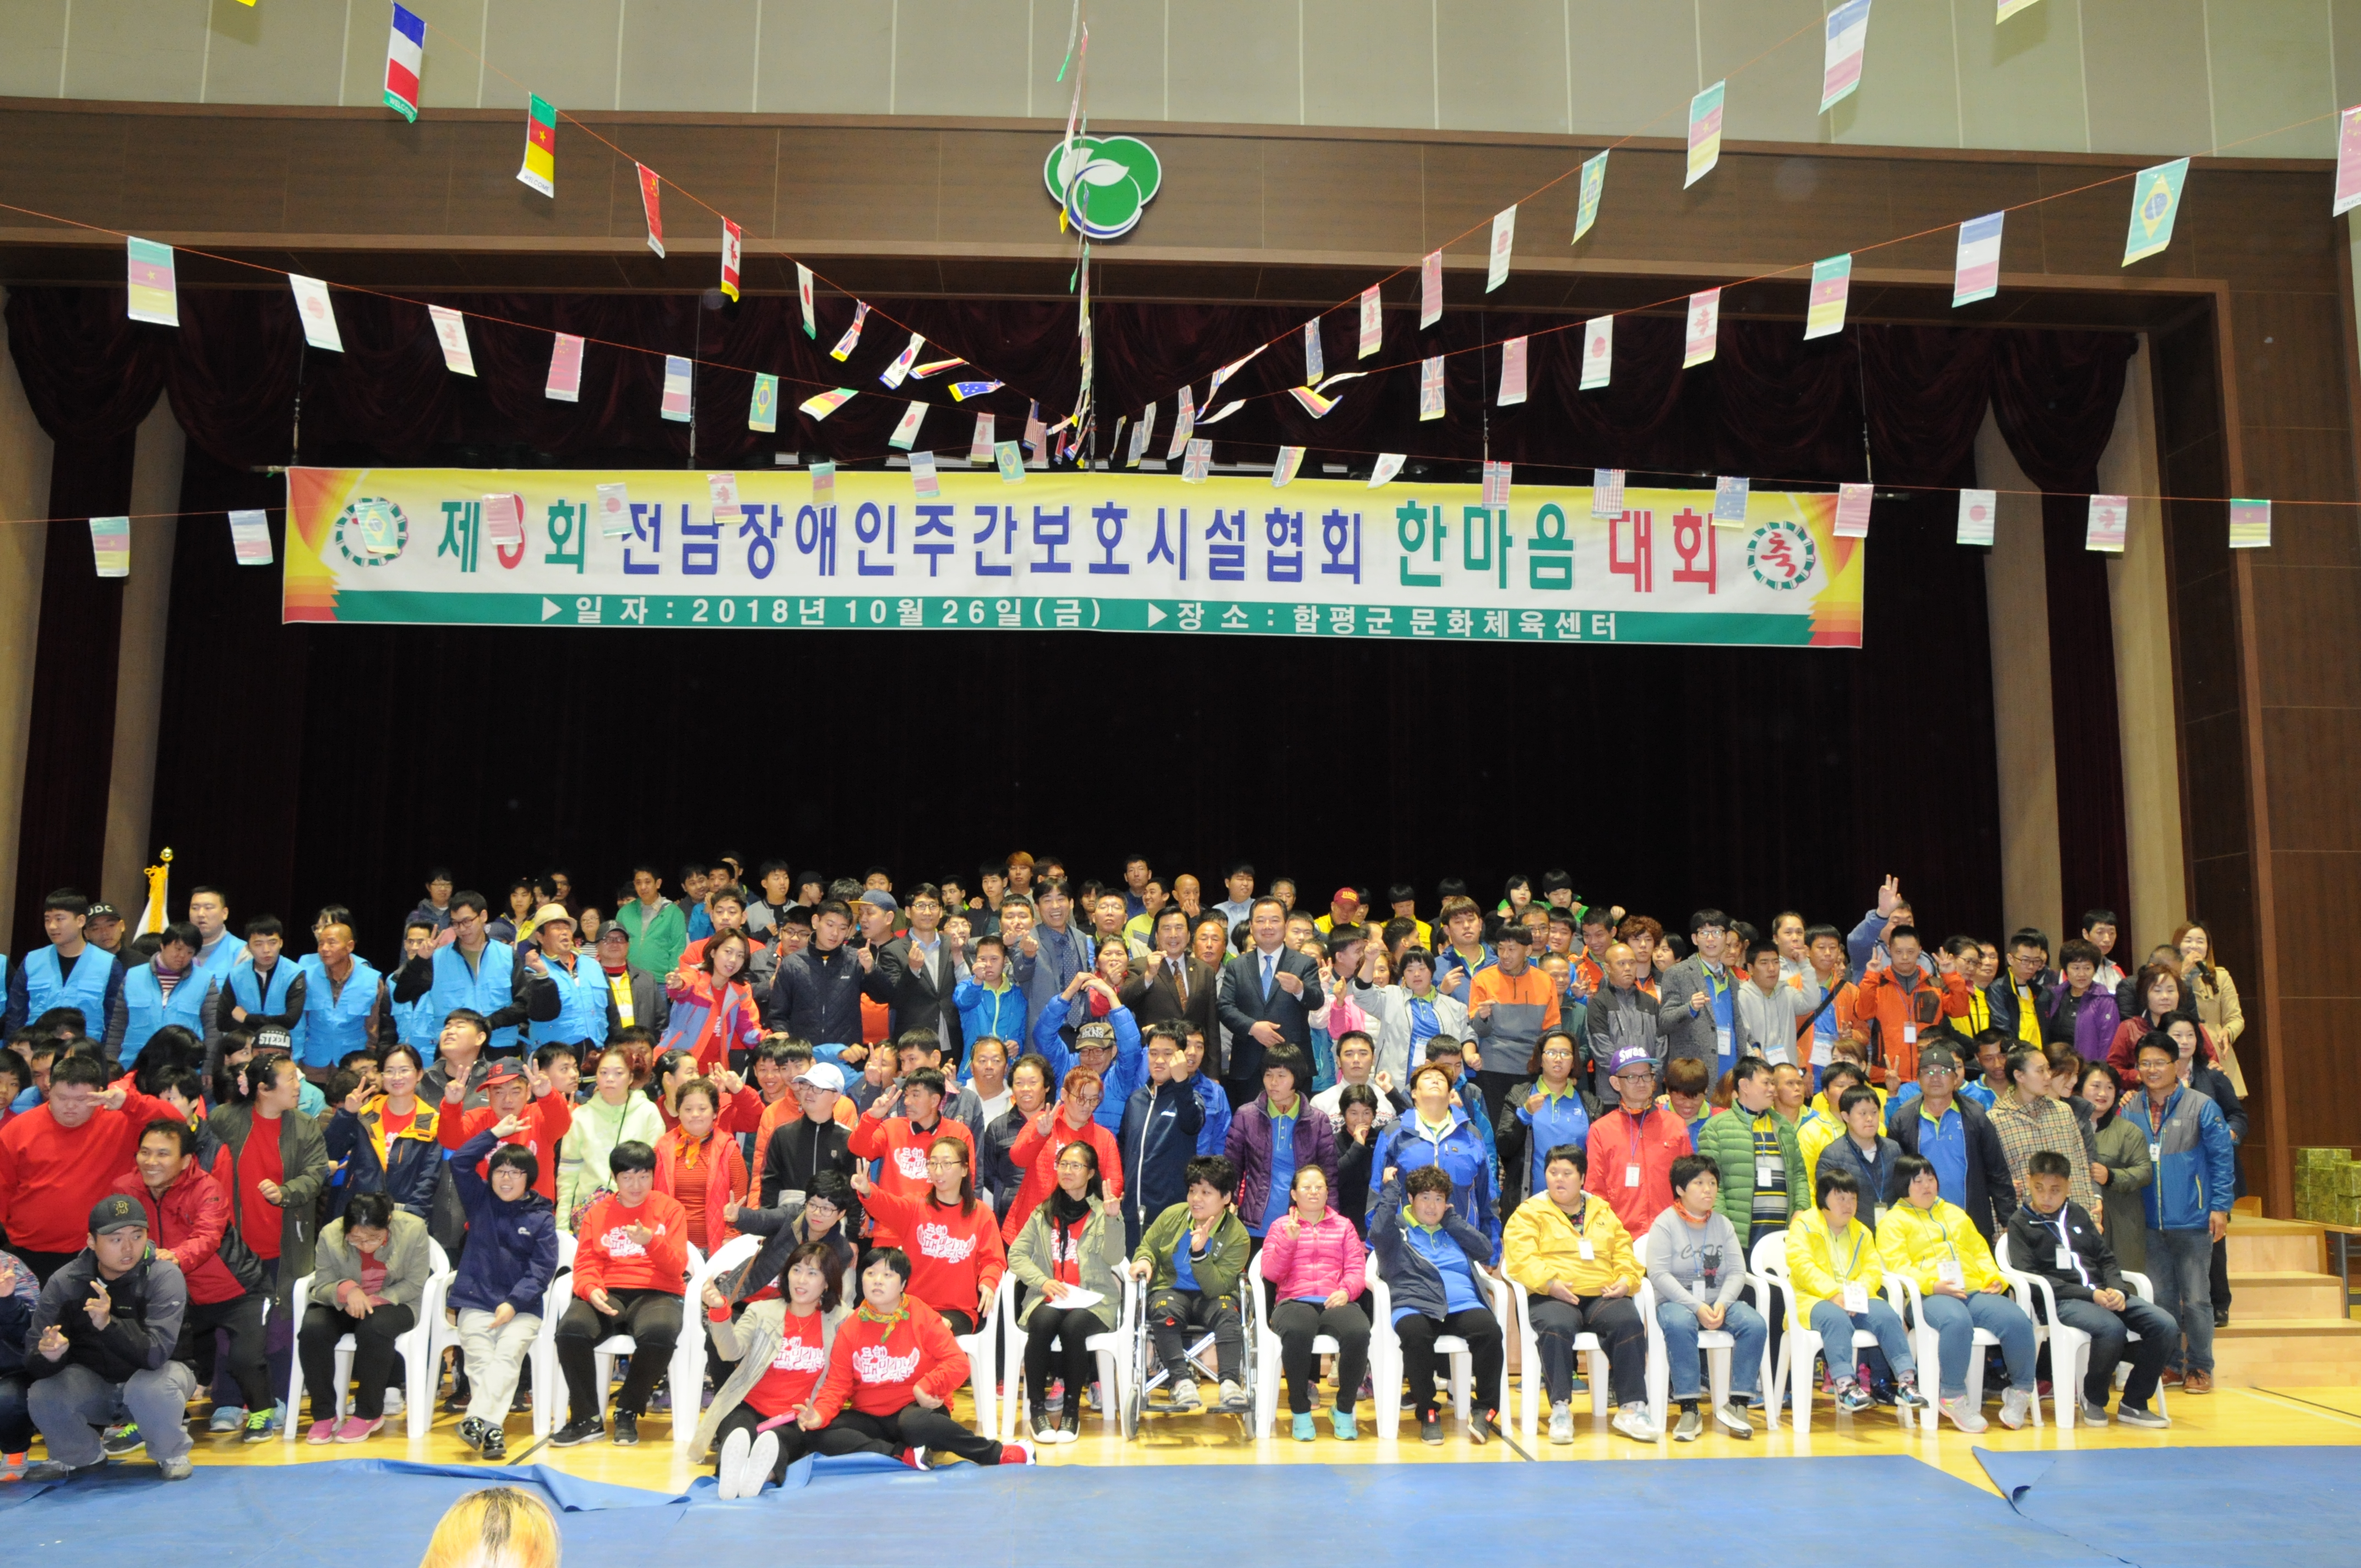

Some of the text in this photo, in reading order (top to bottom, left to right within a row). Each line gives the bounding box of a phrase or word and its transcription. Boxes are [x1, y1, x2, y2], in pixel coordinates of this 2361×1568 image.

[389, 96, 415, 119] WELCOME
[524, 173, 550, 193] WELCOME
[622, 502, 1361, 584] 전남장애인주간보호시설협회
[1396, 500, 1574, 591] 한마음
[1609, 508, 1716, 594] 대회
[1760, 531, 1796, 578] 축
[692, 598, 825, 625] 2018년
[845, 598, 923, 626] 10월
[942, 598, 1100, 627] 26일(금)
[1293, 605, 1393, 634] 함평군
[1410, 608, 1615, 641] 문화체육센터
[924, 1224, 947, 1238] 동행
[923, 1237, 966, 1256] 패밀리가
[862, 1347, 886, 1363] 동행
[862, 1358, 907, 1380] 패밀리가
